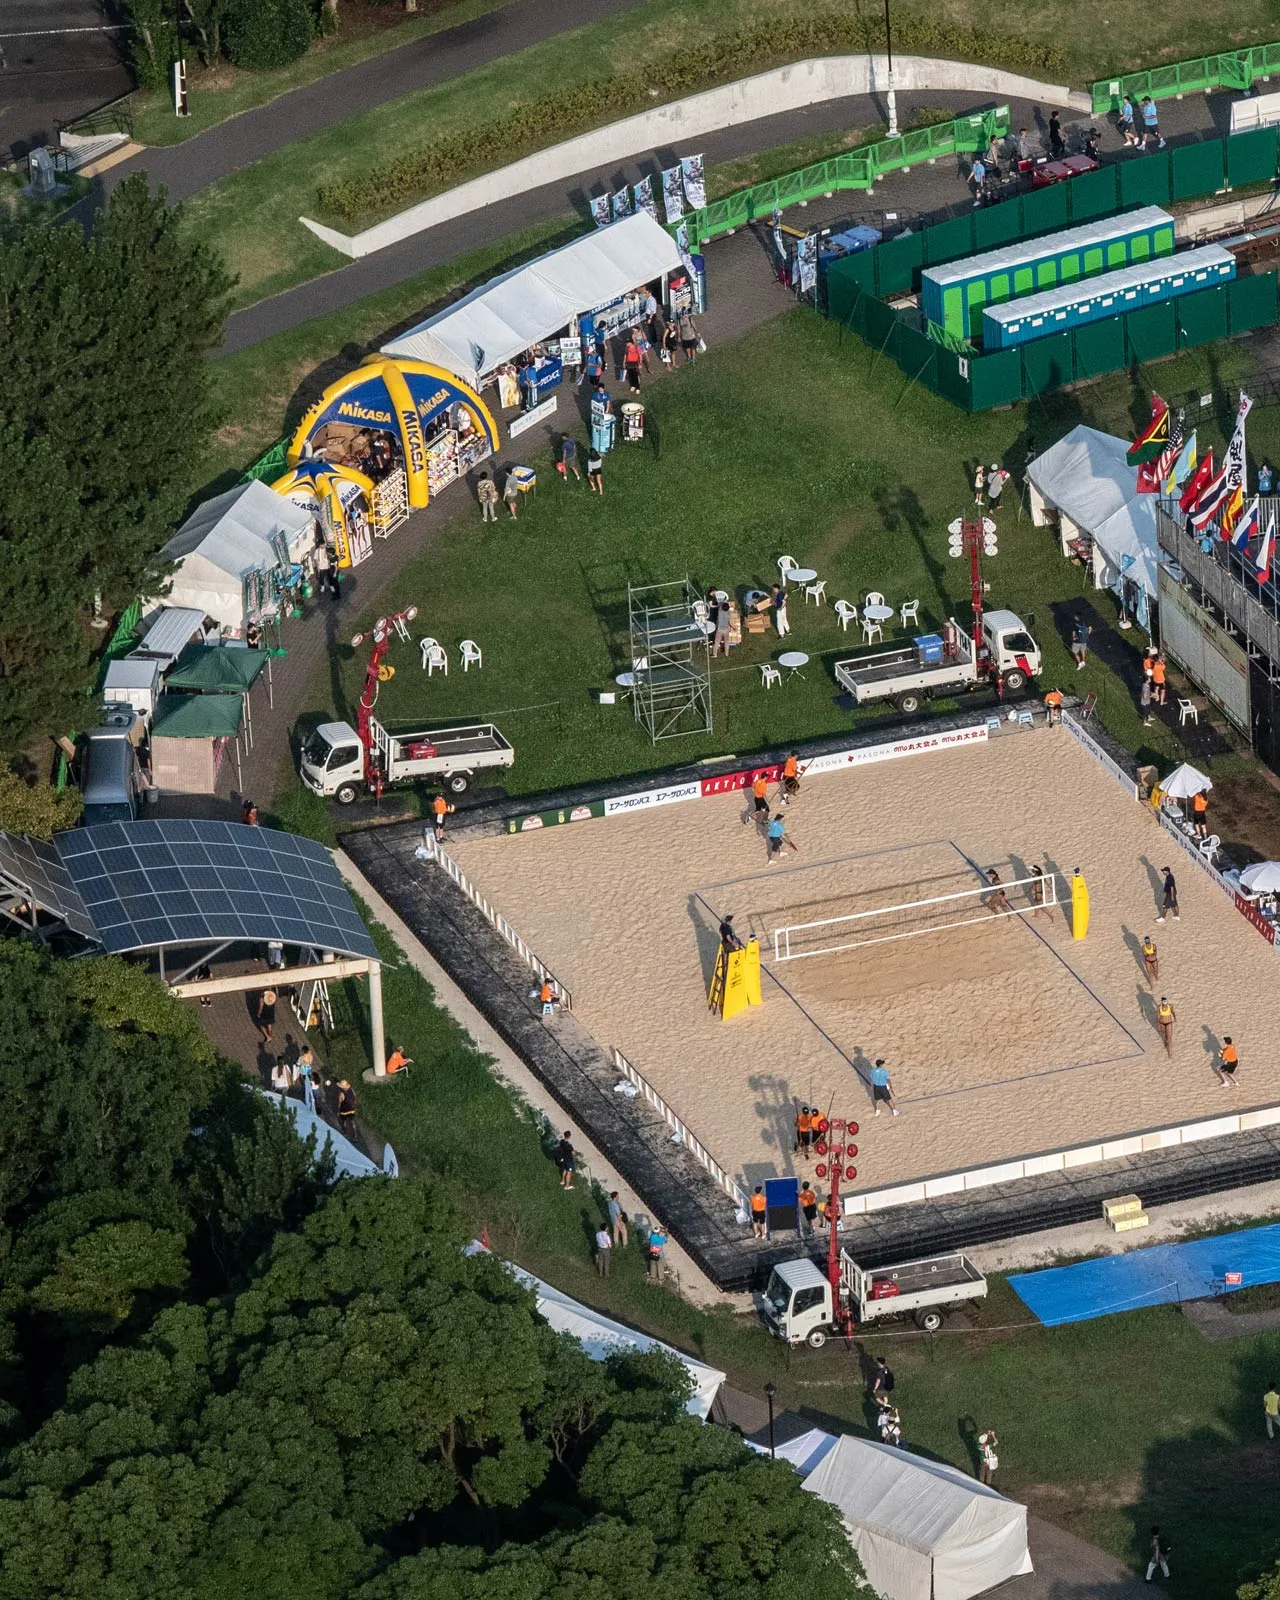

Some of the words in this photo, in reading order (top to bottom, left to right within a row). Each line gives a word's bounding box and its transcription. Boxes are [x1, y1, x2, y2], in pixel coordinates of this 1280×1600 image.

[402, 410, 424, 474] MIKASA
[857, 749, 891, 760] PASONA
[705, 776, 746, 791] AKTIO
